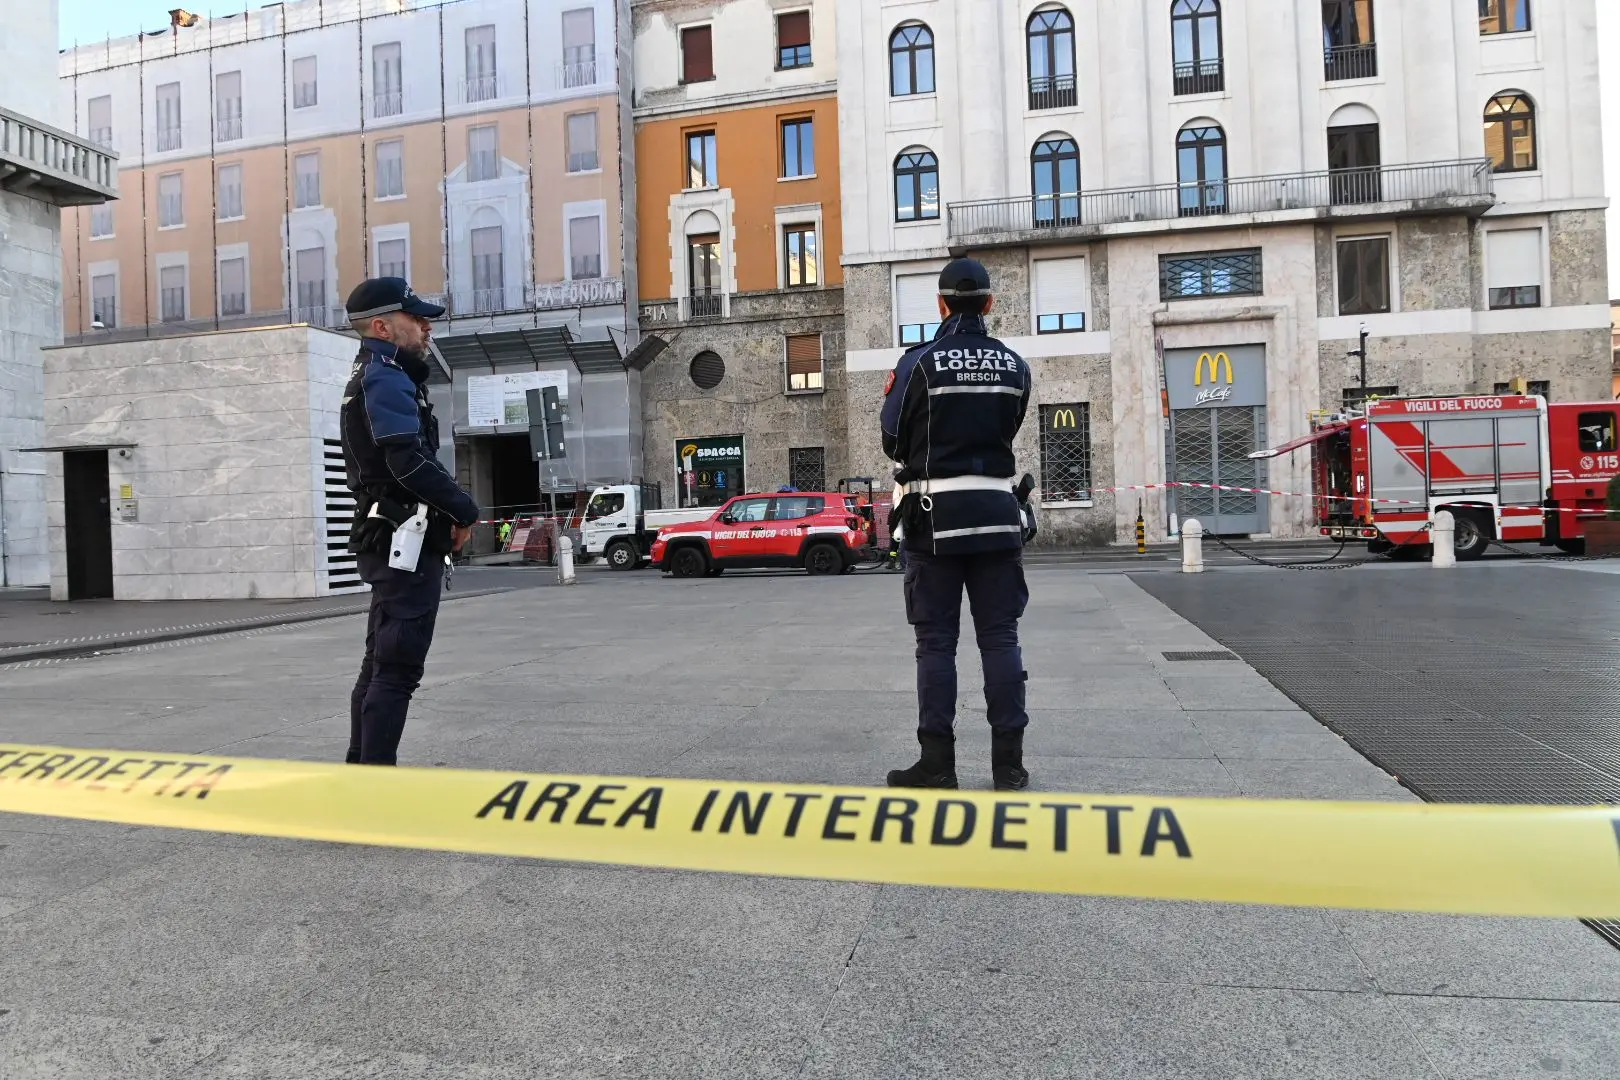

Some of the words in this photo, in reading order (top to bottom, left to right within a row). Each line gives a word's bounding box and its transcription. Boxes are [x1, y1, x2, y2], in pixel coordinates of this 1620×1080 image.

[933, 348, 1015, 363] POLIZIA
[935, 359, 1018, 373] LOCALE
[956, 372, 1001, 382] BRESCIA
[1405, 401, 1437, 412] VIGILI
[1440, 399, 1461, 411] DEL
[1464, 398, 1502, 409] FUOCO
[697, 446, 741, 457] SPACCA
[1597, 455, 1619, 469] 115
[715, 530, 737, 539] VIGILI
[737, 530, 749, 539] DEL
[751, 529, 777, 538] FUOCO
[475, 780, 664, 830] AREA
[691, 789, 1193, 858] INTERDETTA
